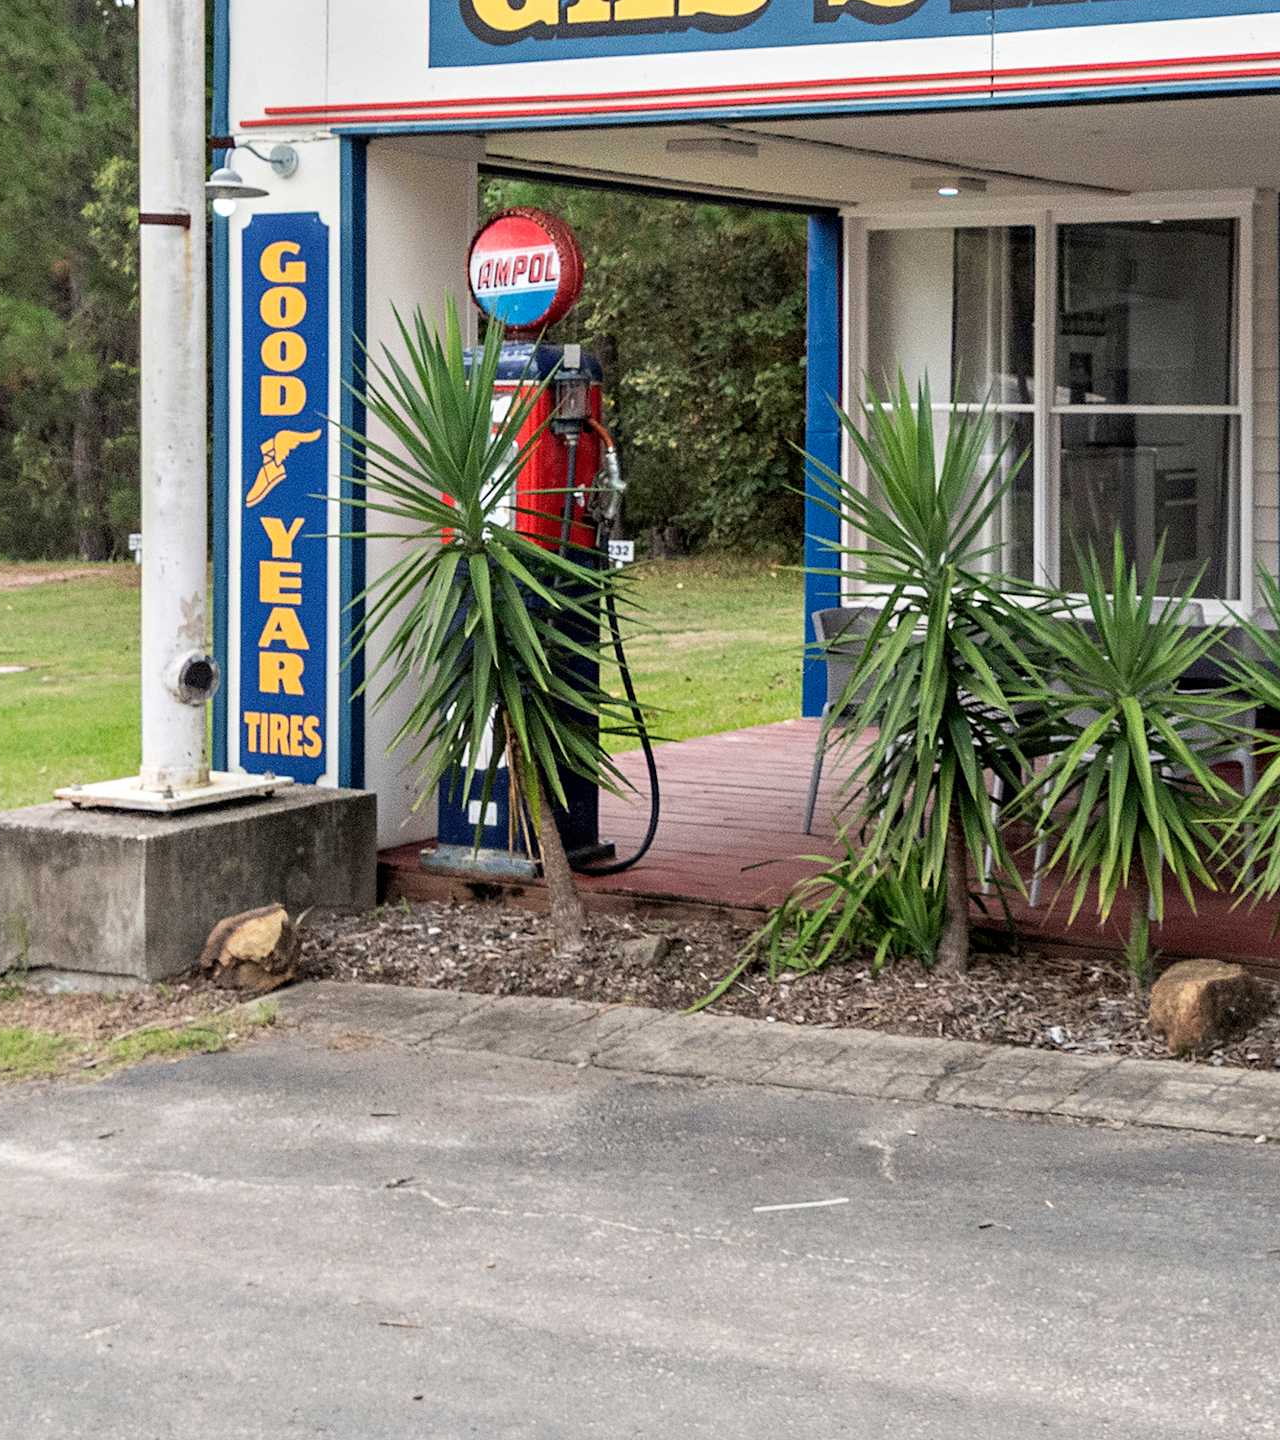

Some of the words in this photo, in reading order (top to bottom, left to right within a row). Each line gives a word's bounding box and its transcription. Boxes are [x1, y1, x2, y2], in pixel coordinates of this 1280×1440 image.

[477, 251, 557, 290] AMPOL
[260, 241, 308, 416] GOOD
[259, 517, 310, 697] YEAR
[244, 712, 322, 758] TIRES
